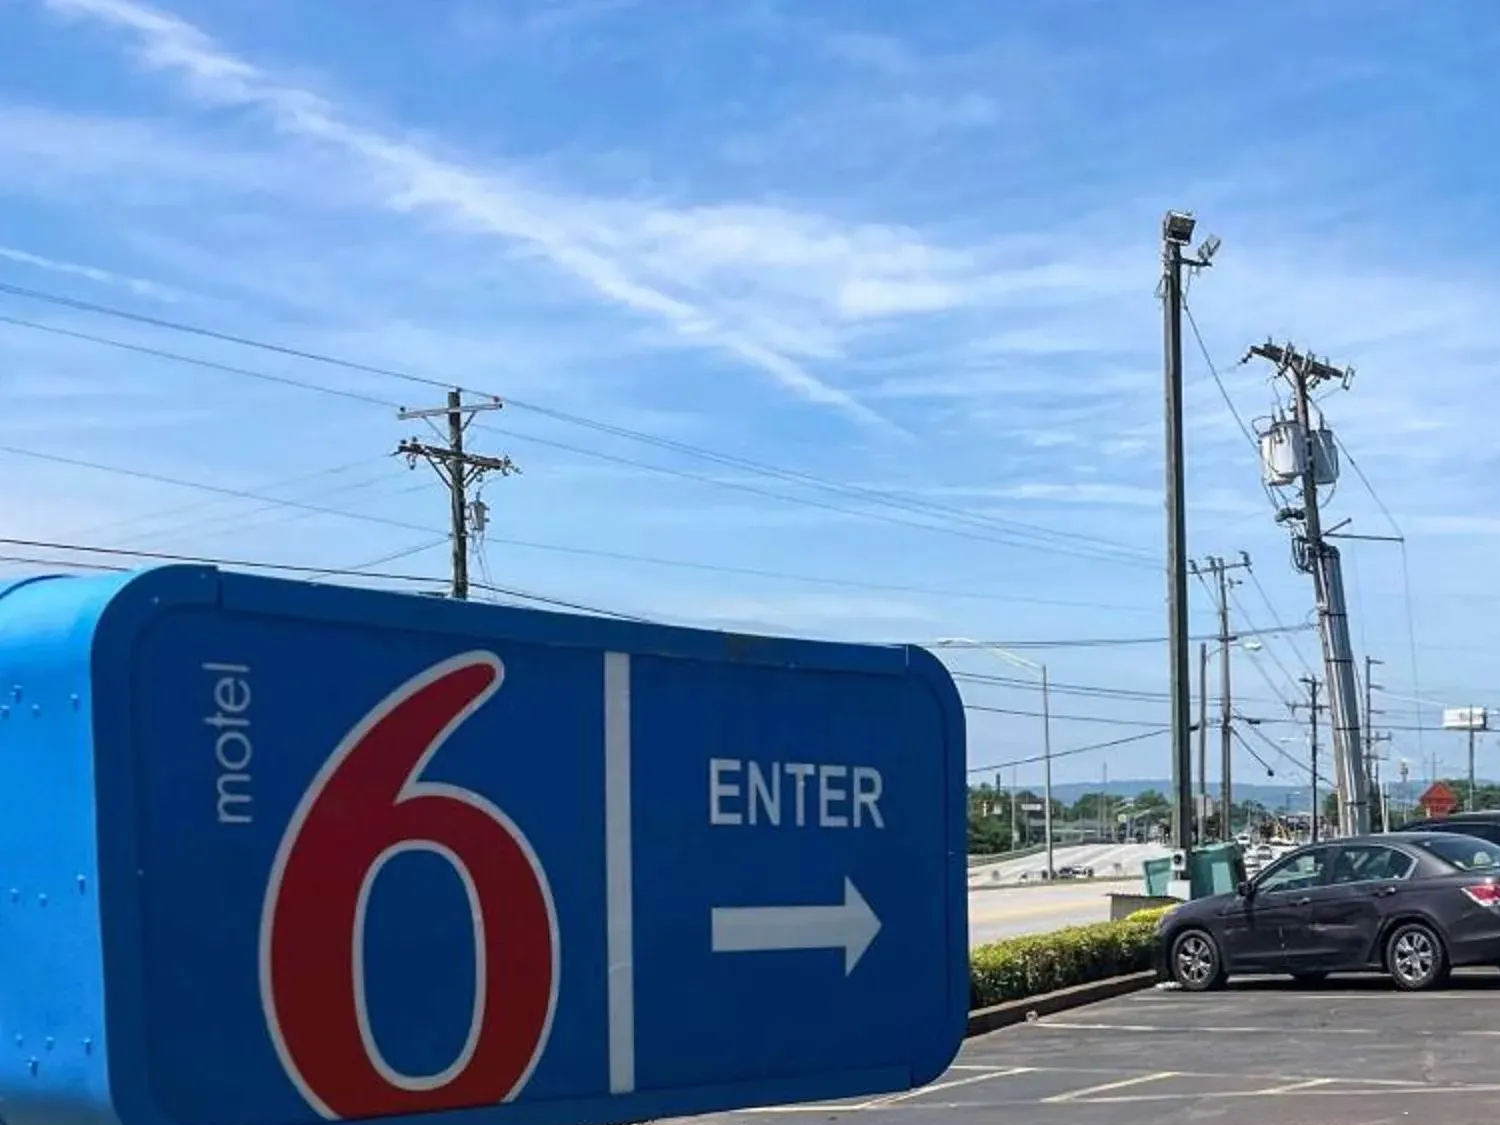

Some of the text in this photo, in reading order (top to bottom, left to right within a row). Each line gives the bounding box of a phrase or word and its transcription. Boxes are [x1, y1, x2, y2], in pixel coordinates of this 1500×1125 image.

[201, 649, 561, 1121] motel 6
[709, 757, 885, 829] ENTER
